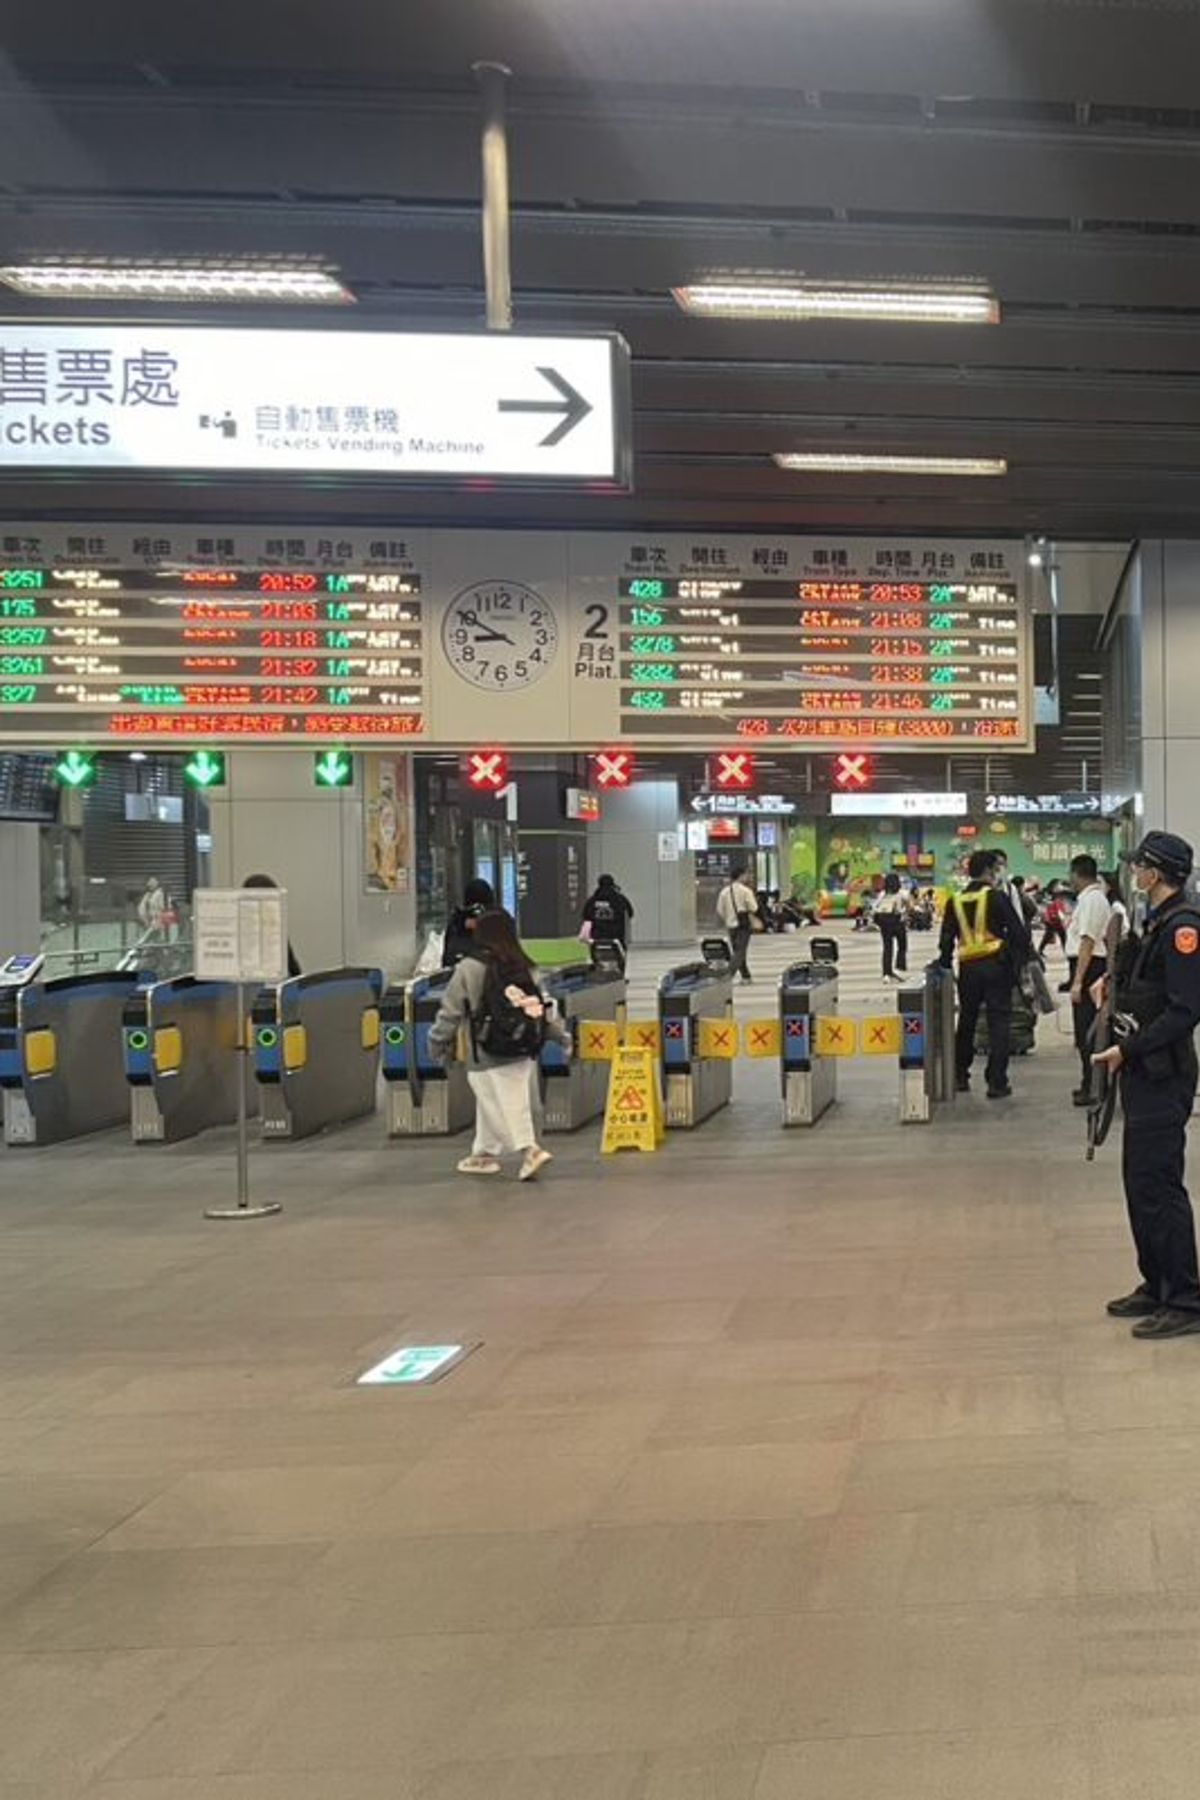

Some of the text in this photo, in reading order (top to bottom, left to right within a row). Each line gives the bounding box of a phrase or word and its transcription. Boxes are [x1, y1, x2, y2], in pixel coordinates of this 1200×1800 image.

[0, 347, 180, 406] 售票處
[255, 405, 399, 433] 自動售票機
[0, 415, 111, 444] ckets
[256, 434, 485, 456] Tickets Vending Machine
[921, 552, 955, 567] 月台
[326, 574, 349, 592] 1A
[628, 579, 663, 598] 428
[870, 583, 922, 601] 20:53
[930, 583, 951, 602] 2A
[474, 593, 491, 612] 11
[493, 593, 511, 609] 12
[519, 592, 525, 612] 1
[326, 603, 349, 620] 1A
[530, 611, 543, 627] 2
[584, 603, 608, 639] 2
[930, 612, 951, 629] 2A
[260, 630, 317, 647] 21:18
[326, 631, 349, 648] 1A
[455, 629, 468, 645] 9
[536, 630, 548, 646] 3
[462, 646, 475, 662] 8
[529, 648, 542, 662] 4
[578, 642, 615, 662] 月台
[260, 659, 317, 676] 21:32
[326, 660, 349, 677] 1A
[477, 661, 490, 677] 7
[494, 665, 508, 682] 6
[514, 661, 528, 678] 5
[575, 662, 617, 679] Plat.
[1, 684, 36, 702] 327
[260, 687, 318, 704] 21:42
[326, 687, 349, 704] 1A
[495, 782, 518, 821] 1
